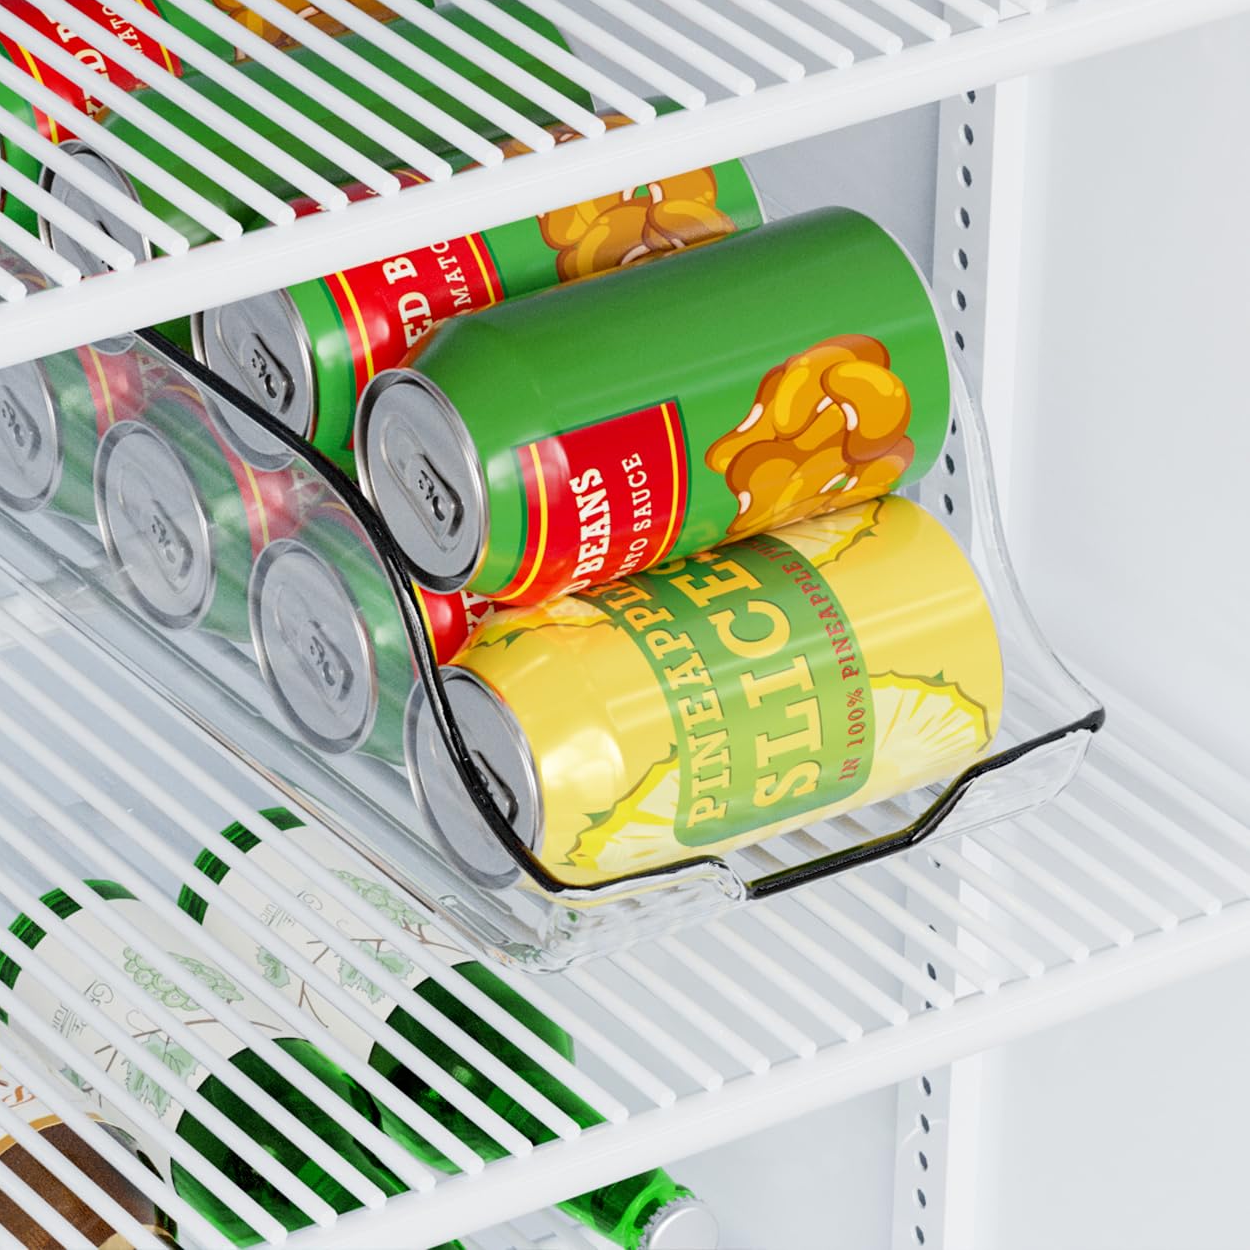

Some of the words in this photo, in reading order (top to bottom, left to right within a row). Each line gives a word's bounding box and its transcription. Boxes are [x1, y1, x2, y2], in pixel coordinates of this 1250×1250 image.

[569, 467, 611, 579] BEANS
[621, 453, 652, 532] SAUCE
[781, 560, 861, 681] PINEAPPLE
[845, 687, 865, 748] 100%
[838, 756, 862, 782] IN
